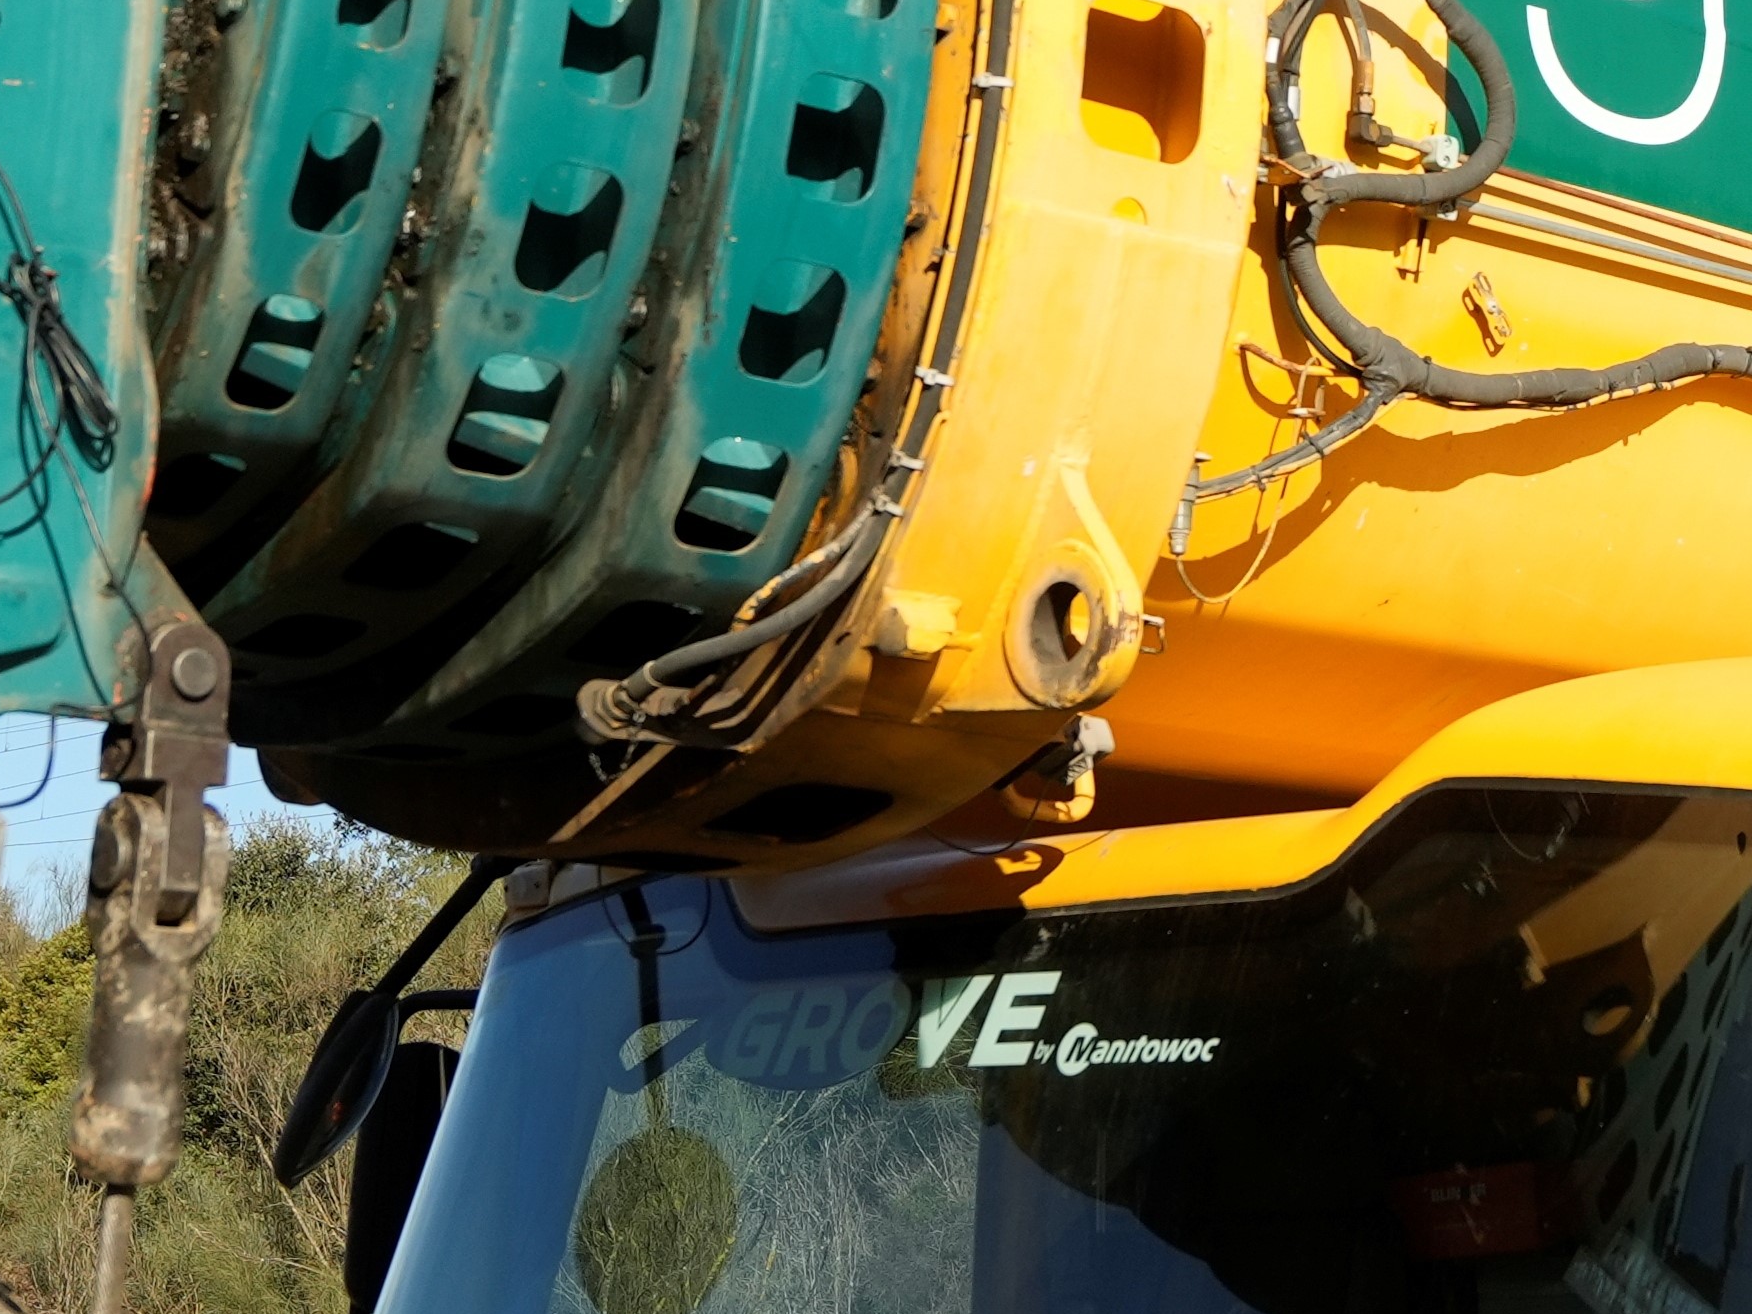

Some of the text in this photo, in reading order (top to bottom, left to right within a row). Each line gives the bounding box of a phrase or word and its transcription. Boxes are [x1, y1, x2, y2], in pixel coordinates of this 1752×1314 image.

[728, 971, 1221, 1077] GROVE by Manitowoc
